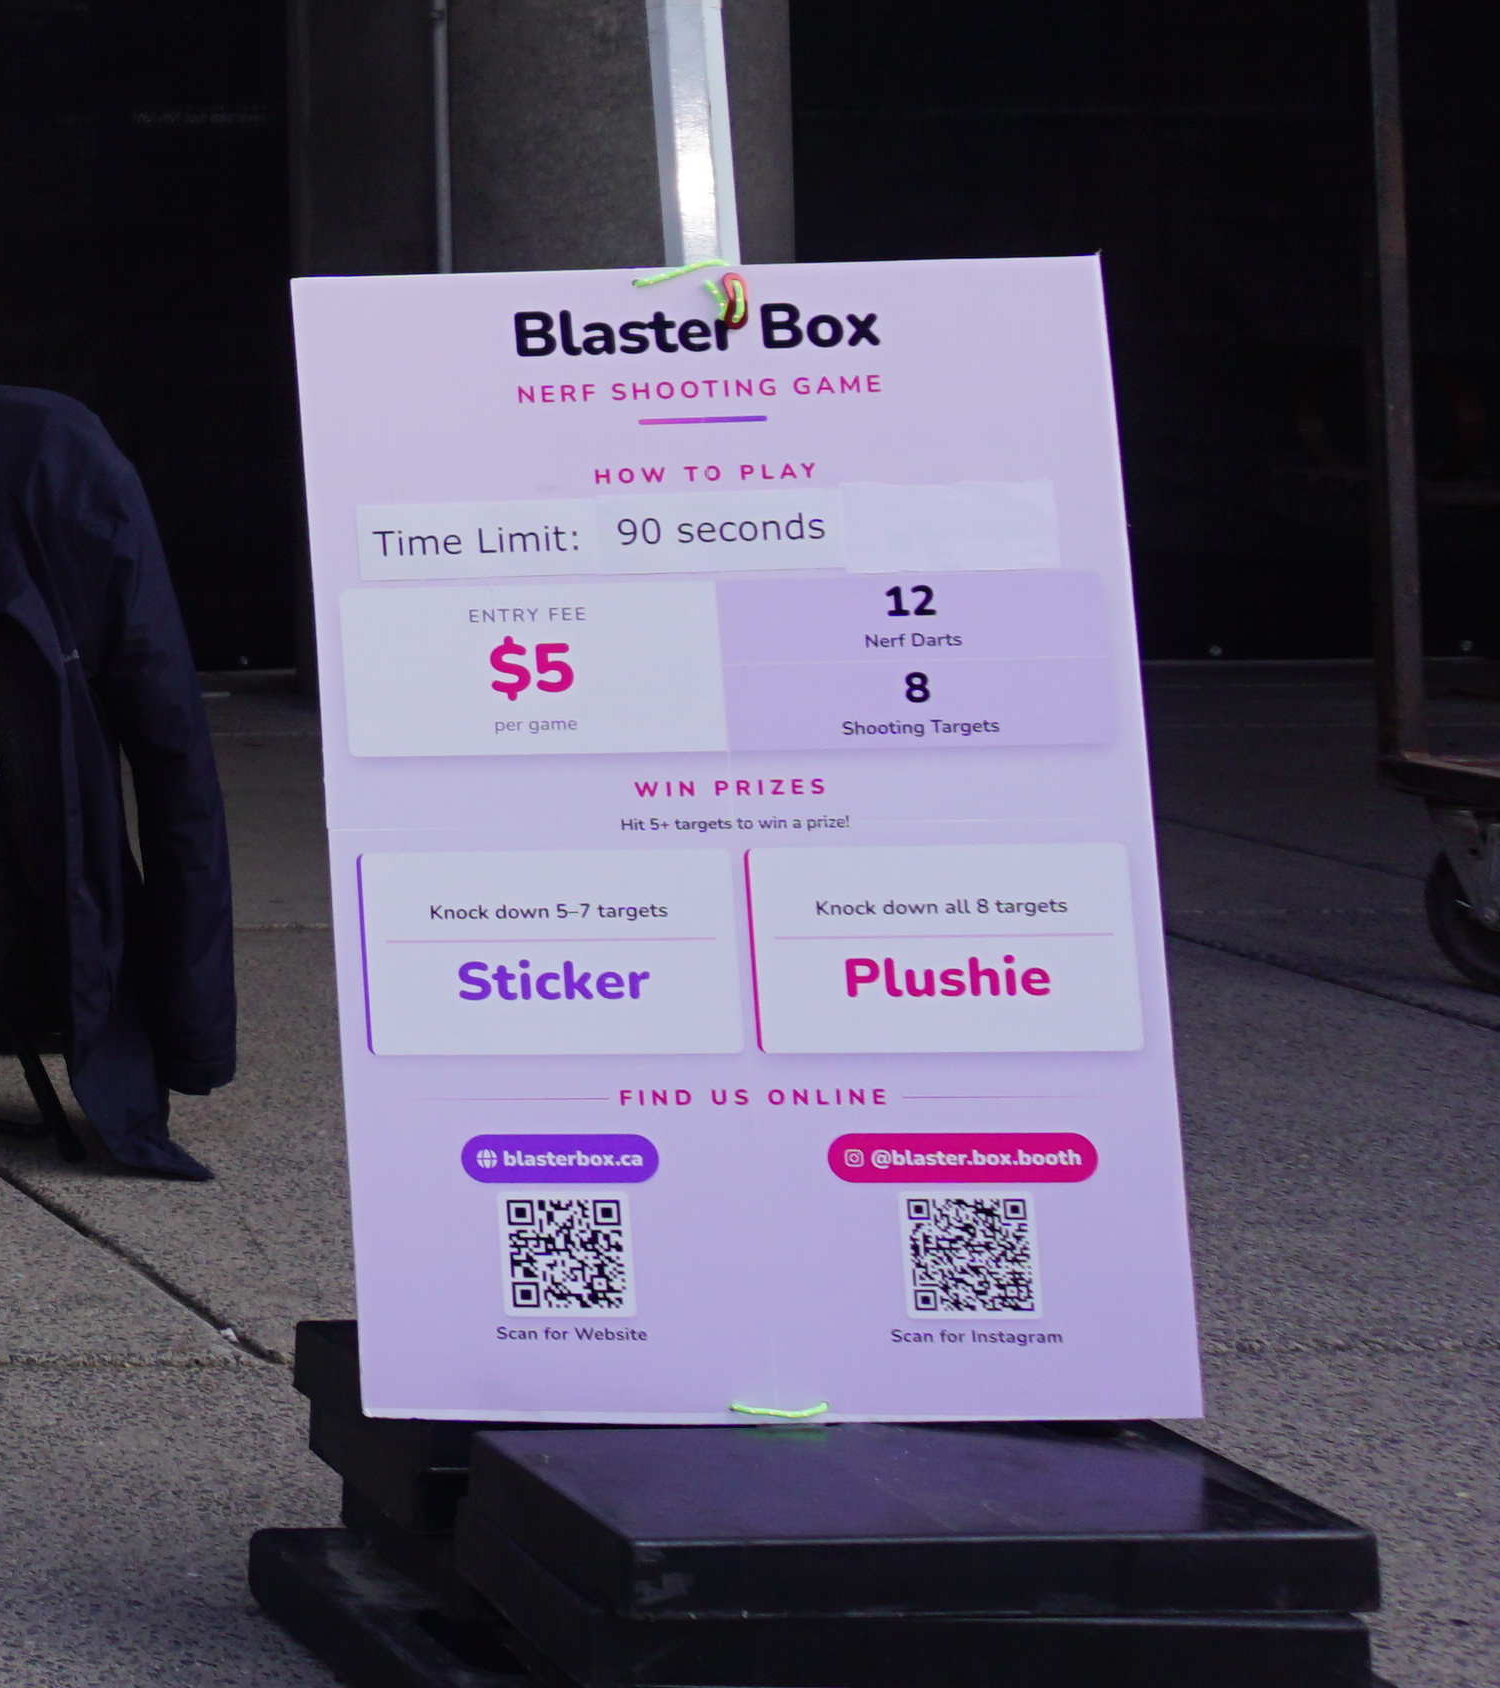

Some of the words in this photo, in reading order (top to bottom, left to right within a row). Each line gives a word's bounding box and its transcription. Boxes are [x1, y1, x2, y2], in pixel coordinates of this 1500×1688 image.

[513, 309, 734, 357] Blaster
[759, 302, 881, 349] Box
[516, 383, 596, 404] NERF
[610, 377, 777, 402] SHOOTING
[792, 374, 882, 396] GAME
[593, 466, 666, 485] HOW
[682, 464, 722, 483] TO
[739, 461, 816, 481] PLAY
[371, 529, 463, 558] Time
[477, 525, 579, 554] Limit:
[616, 517, 662, 546] 90
[677, 511, 826, 545] seconds
[884, 584, 938, 618] 12
[468, 607, 539, 624] ENTRY
[548, 606, 587, 622] FEE
[864, 632, 907, 649] Nerf
[910, 632, 963, 648] Darts
[488, 634, 575, 702] $5
[904, 671, 932, 704] 8
[494, 720, 524, 735] per
[528, 719, 578, 735] game
[841, 719, 926, 738] Shooting
[929, 718, 1001, 737] Targets
[633, 780, 696, 798] WIN
[713, 777, 826, 797] PRIZES
[620, 817, 647, 832] Hit
[649, 817, 670, 831] 5+
[673, 817, 733, 834] targets
[735, 817, 754, 830] to
[757, 815, 788, 830] win
[792, 818, 803, 829] a
[806, 814, 850, 832] prize!
[429, 904, 490, 921] Knock
[494, 903, 550, 920] down
[596, 903, 669, 922] targets
[815, 899, 877, 917] Knock
[882, 899, 939, 916] down
[944, 898, 972, 915] all
[976, 897, 990, 915] 8
[993, 898, 1069, 918] targets
[457, 958, 651, 1002] Sticker
[843, 953, 1052, 999] Plushie
[618, 1088, 693, 1107] FIND
[710, 1088, 750, 1106] US
[767, 1087, 887, 1106] ONLINE
[502, 1149, 645, 1168] blasterbox.ca
[869, 1147, 1084, 1170] @blaster.box.booth
[496, 1325, 538, 1341] Scan
[543, 1326, 570, 1341] for
[573, 1326, 648, 1342] Website
[890, 1328, 934, 1344] Scan
[938, 1328, 966, 1344] for
[970, 1329, 1064, 1347] Instagram
